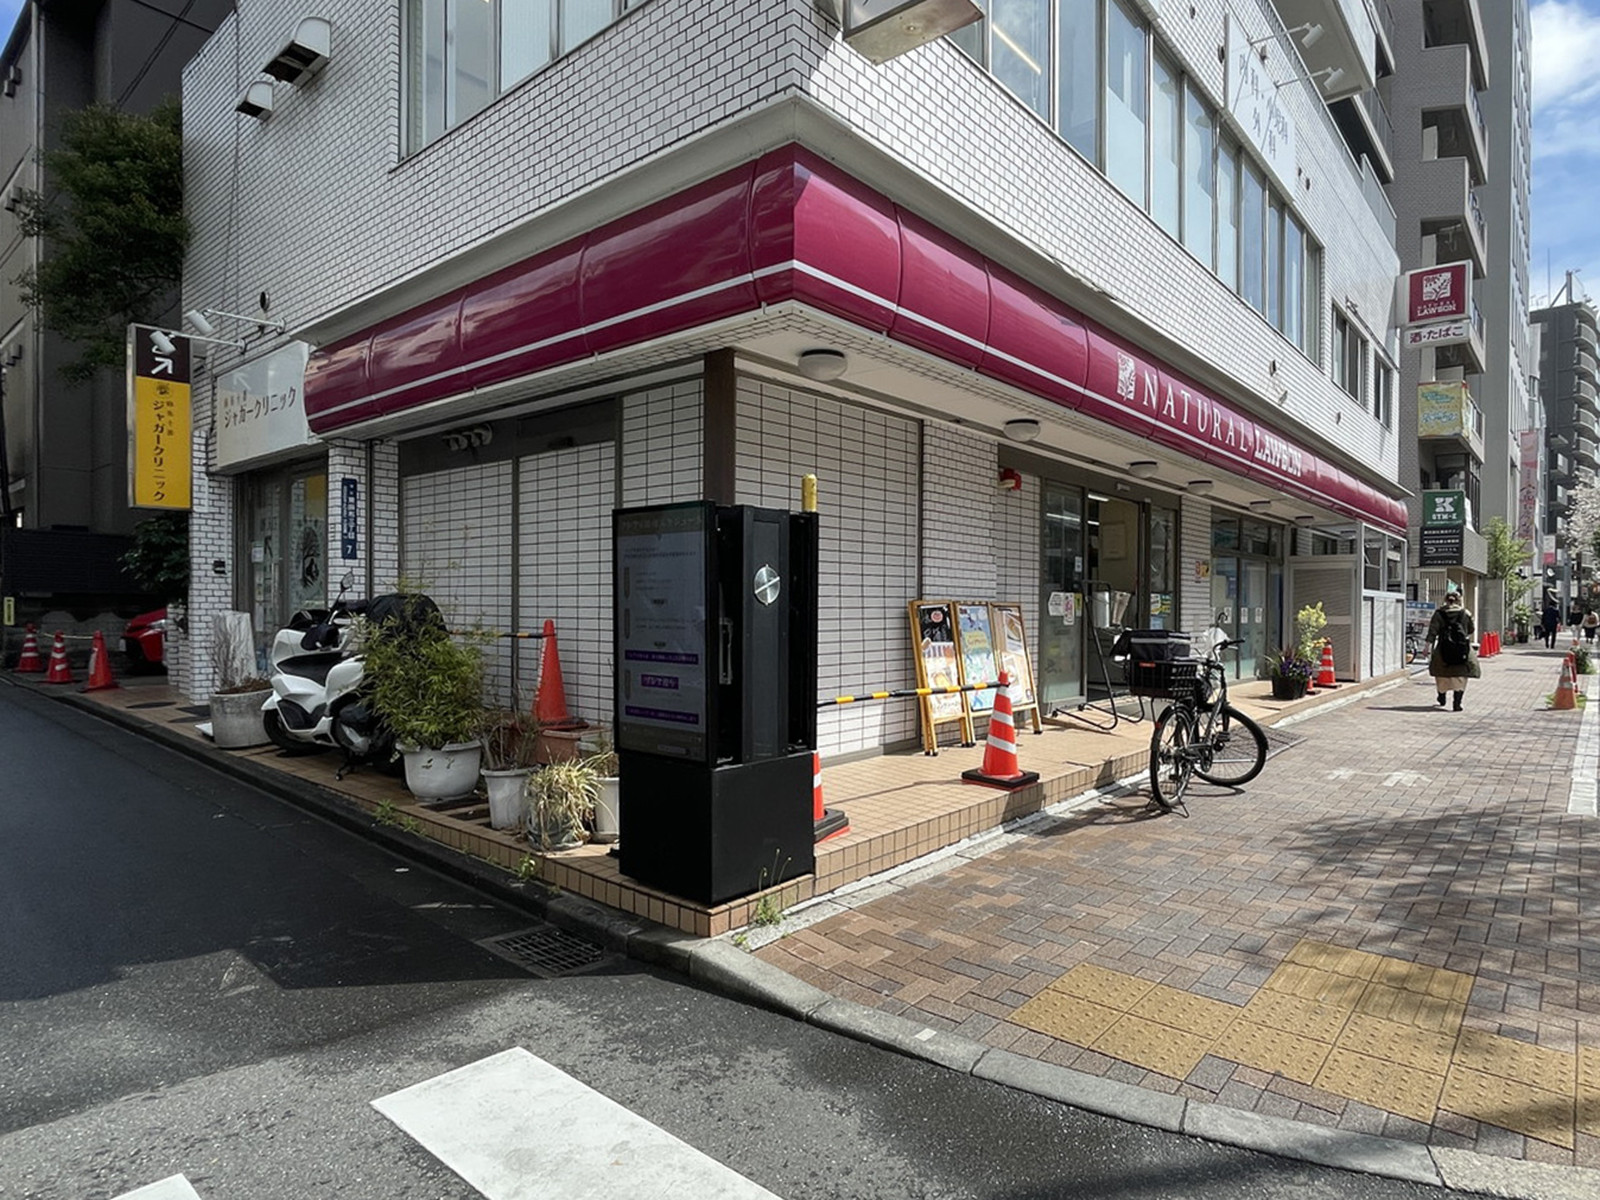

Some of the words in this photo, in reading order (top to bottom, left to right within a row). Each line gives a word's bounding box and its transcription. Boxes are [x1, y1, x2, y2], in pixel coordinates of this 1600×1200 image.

[1417, 304, 1457, 317] LAWSON
[1409, 325, 1464, 344] 酒・たばこ
[225, 386, 296, 429] ジャガークリニック
[1143, 369, 1248, 453] NATURAL
[1254, 428, 1302, 477] LAWSON
[152, 400, 166, 502] ジャガークリニック
